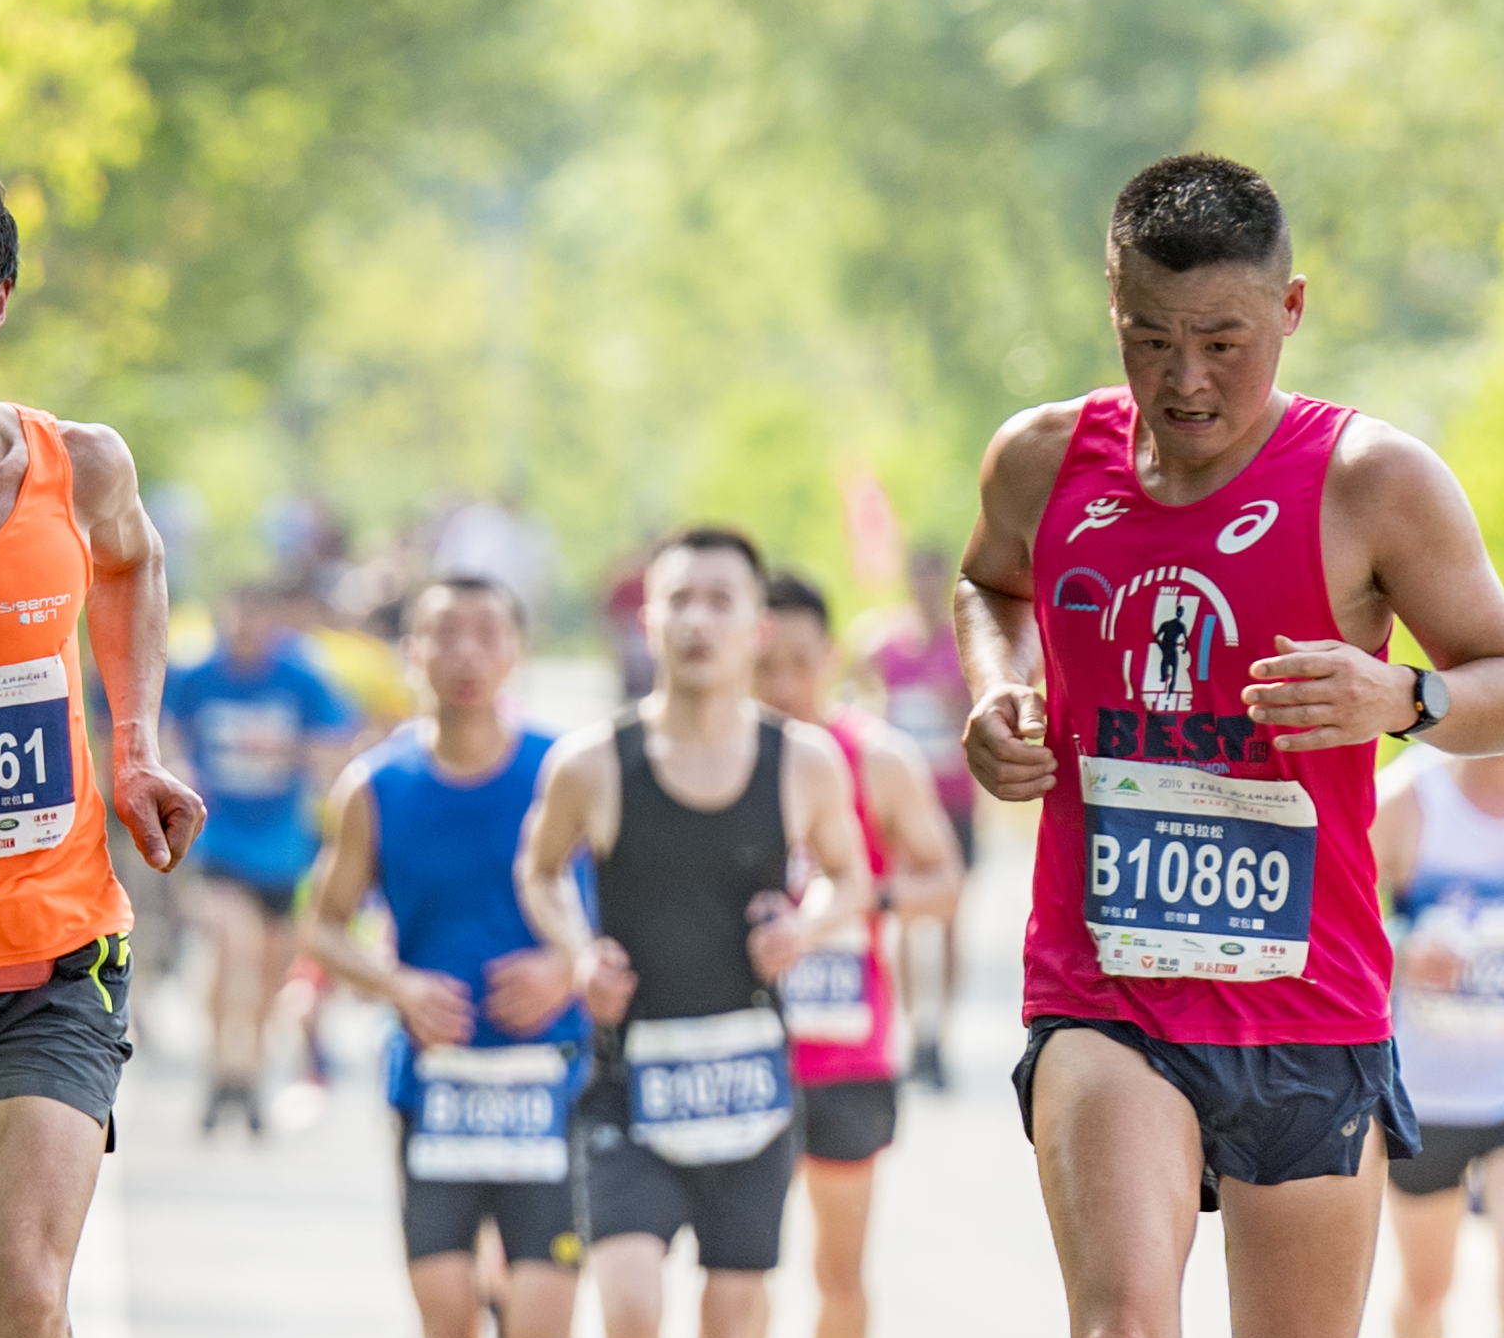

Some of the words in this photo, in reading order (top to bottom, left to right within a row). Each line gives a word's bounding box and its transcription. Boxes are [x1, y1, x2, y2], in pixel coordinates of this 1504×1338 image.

[1141, 693, 1193, 711] THE
[1096, 706, 1255, 761] BEST
[1158, 778, 1182, 789] 2019
[1154, 821, 1225, 839] 半程马拉松
[1092, 833, 1290, 912] B10869
